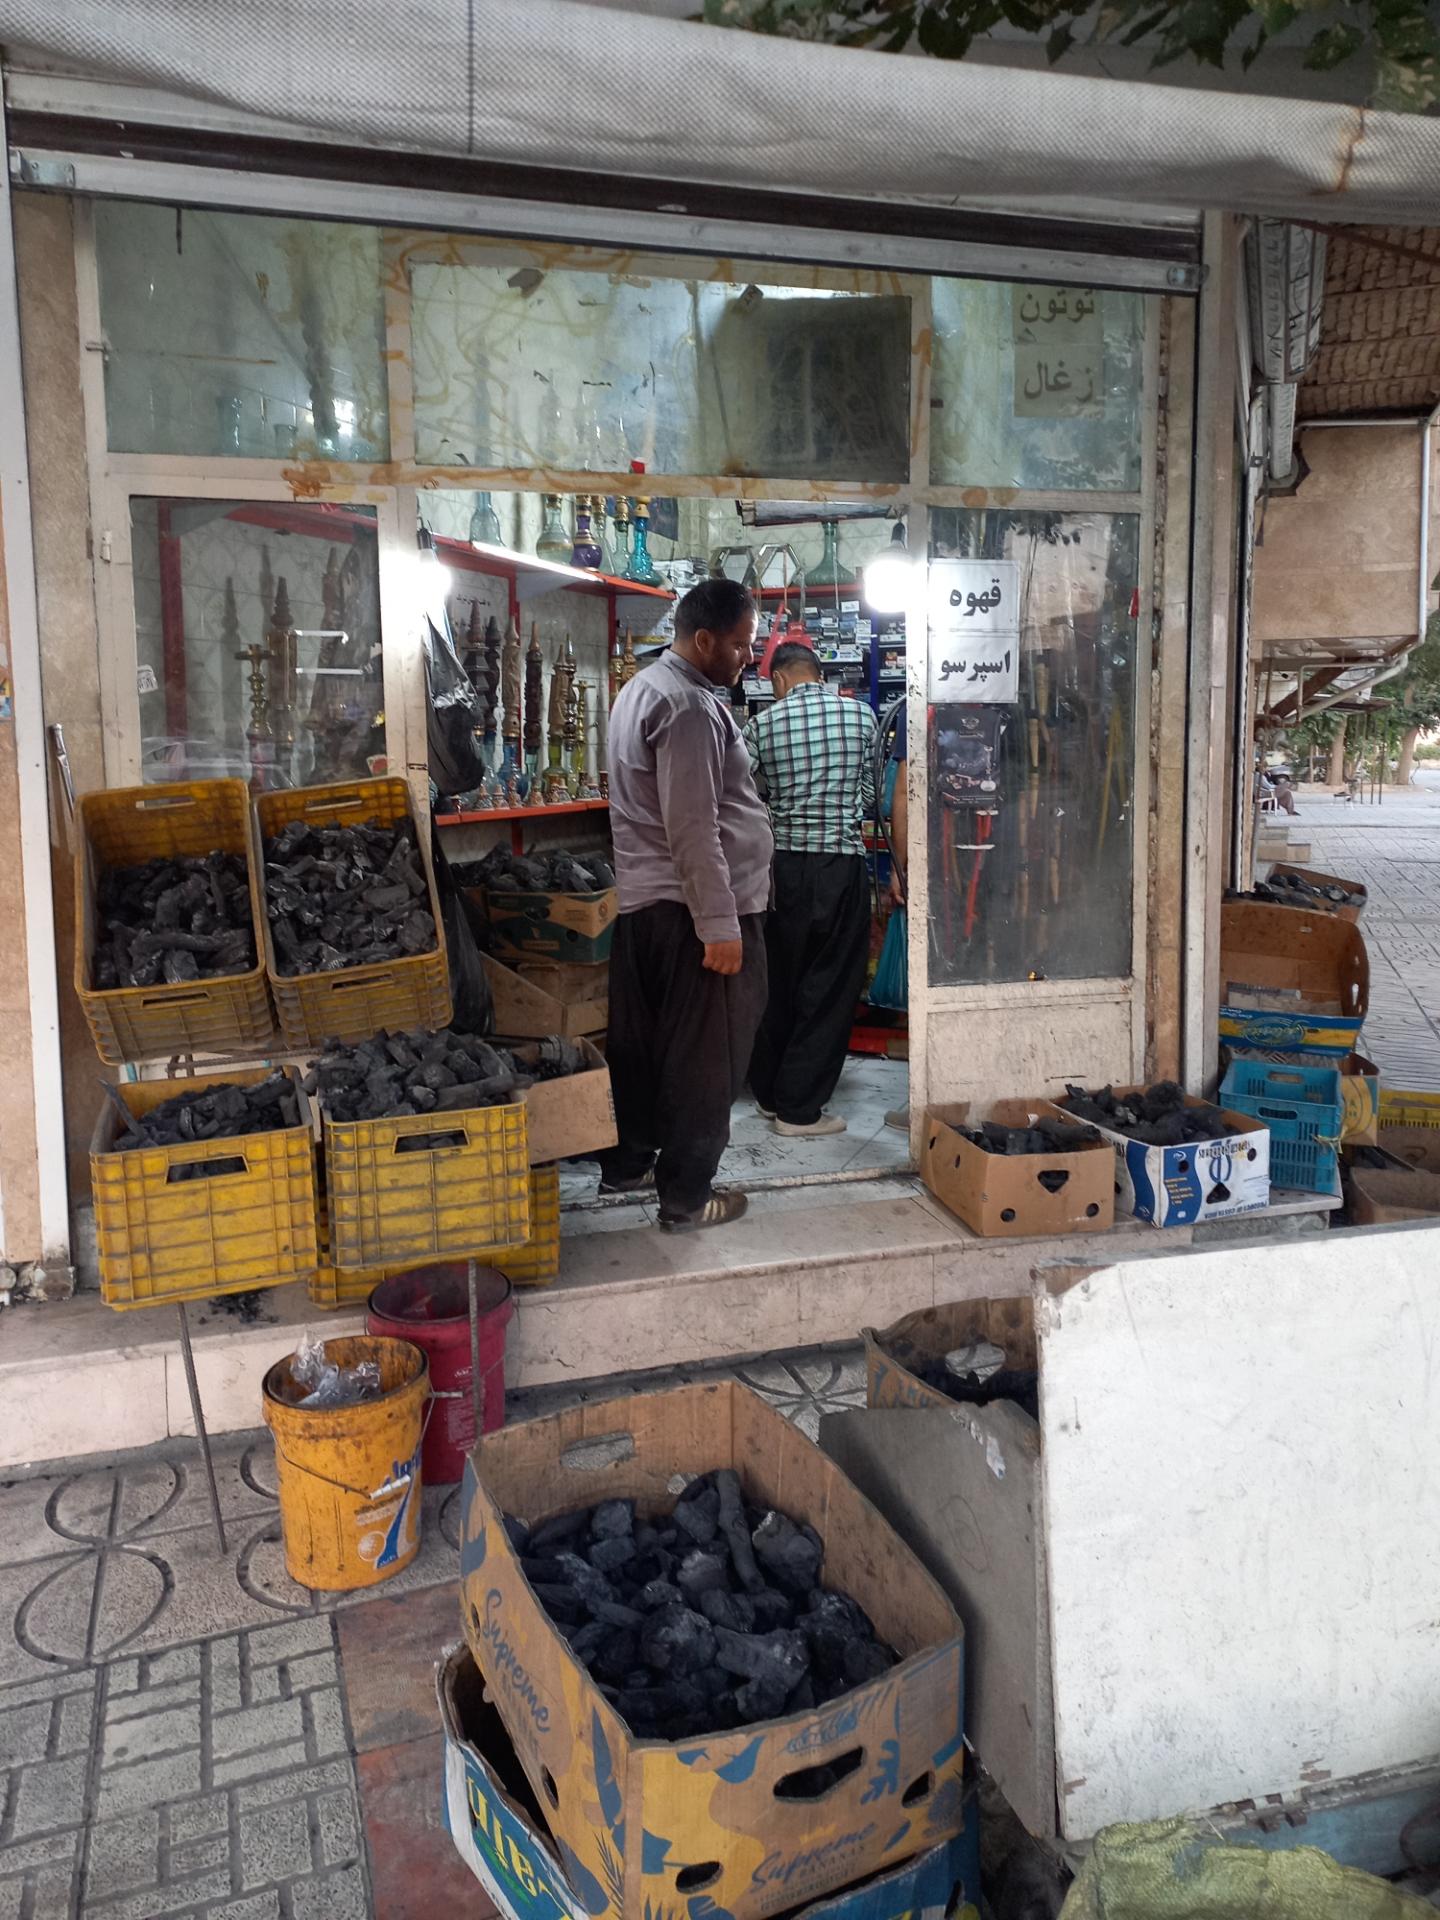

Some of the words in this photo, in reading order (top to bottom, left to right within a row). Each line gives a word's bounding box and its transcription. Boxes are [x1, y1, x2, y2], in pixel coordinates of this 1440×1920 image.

[1020, 289, 1095, 323] توتون
[1023, 360, 1094, 402] زغال
[949, 578, 1001, 617] قهوه
[937, 649, 1010, 682] اسپرسو
[482, 1588, 551, 1733] Supreme
